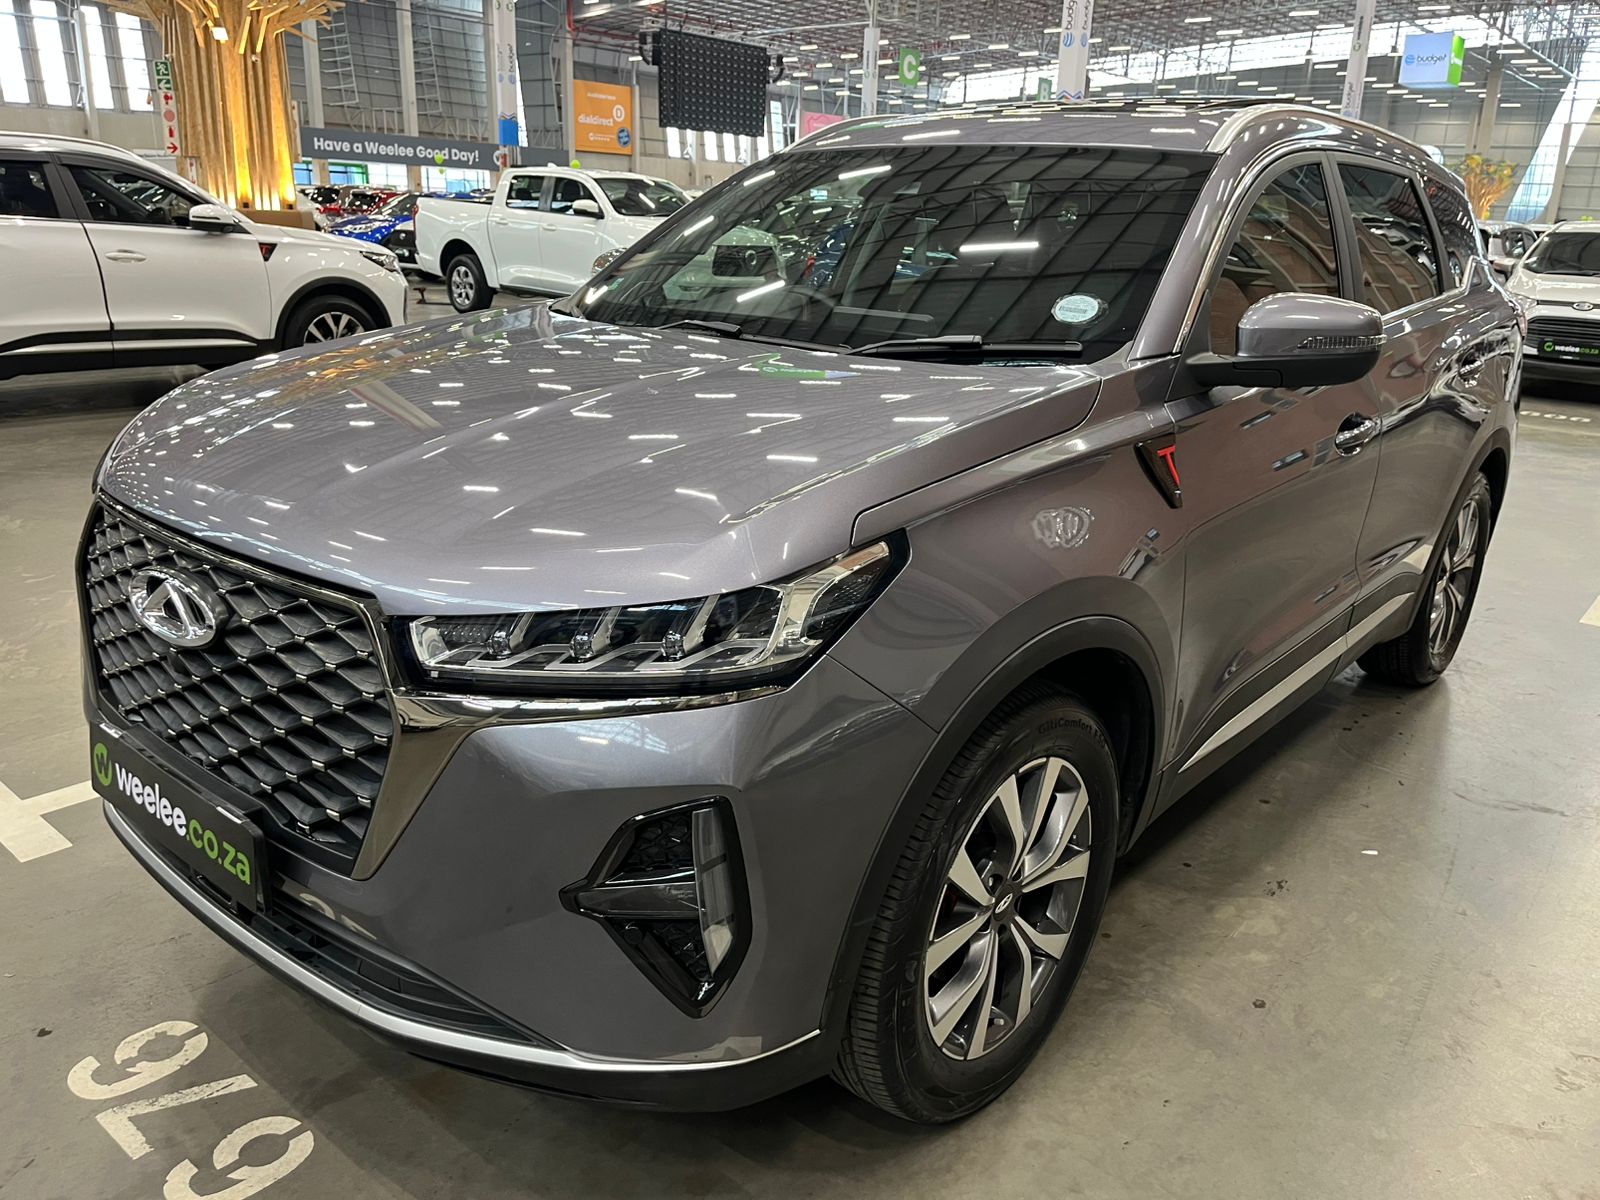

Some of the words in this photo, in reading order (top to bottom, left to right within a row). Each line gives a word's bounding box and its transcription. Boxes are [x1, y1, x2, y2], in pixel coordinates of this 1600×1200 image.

[903, 54, 916, 80] C
[1417, 53, 1446, 64] budget
[313, 137, 351, 153] Have
[353, 143, 363, 154] a
[364, 141, 414, 158] Weelee
[416, 146, 450, 160] Good
[451, 149, 479, 166] Day!
[1554, 345, 1599, 354] weelee.co.za
[1157, 445, 1181, 489] T
[115, 762, 250, 885] weelee.co.za
